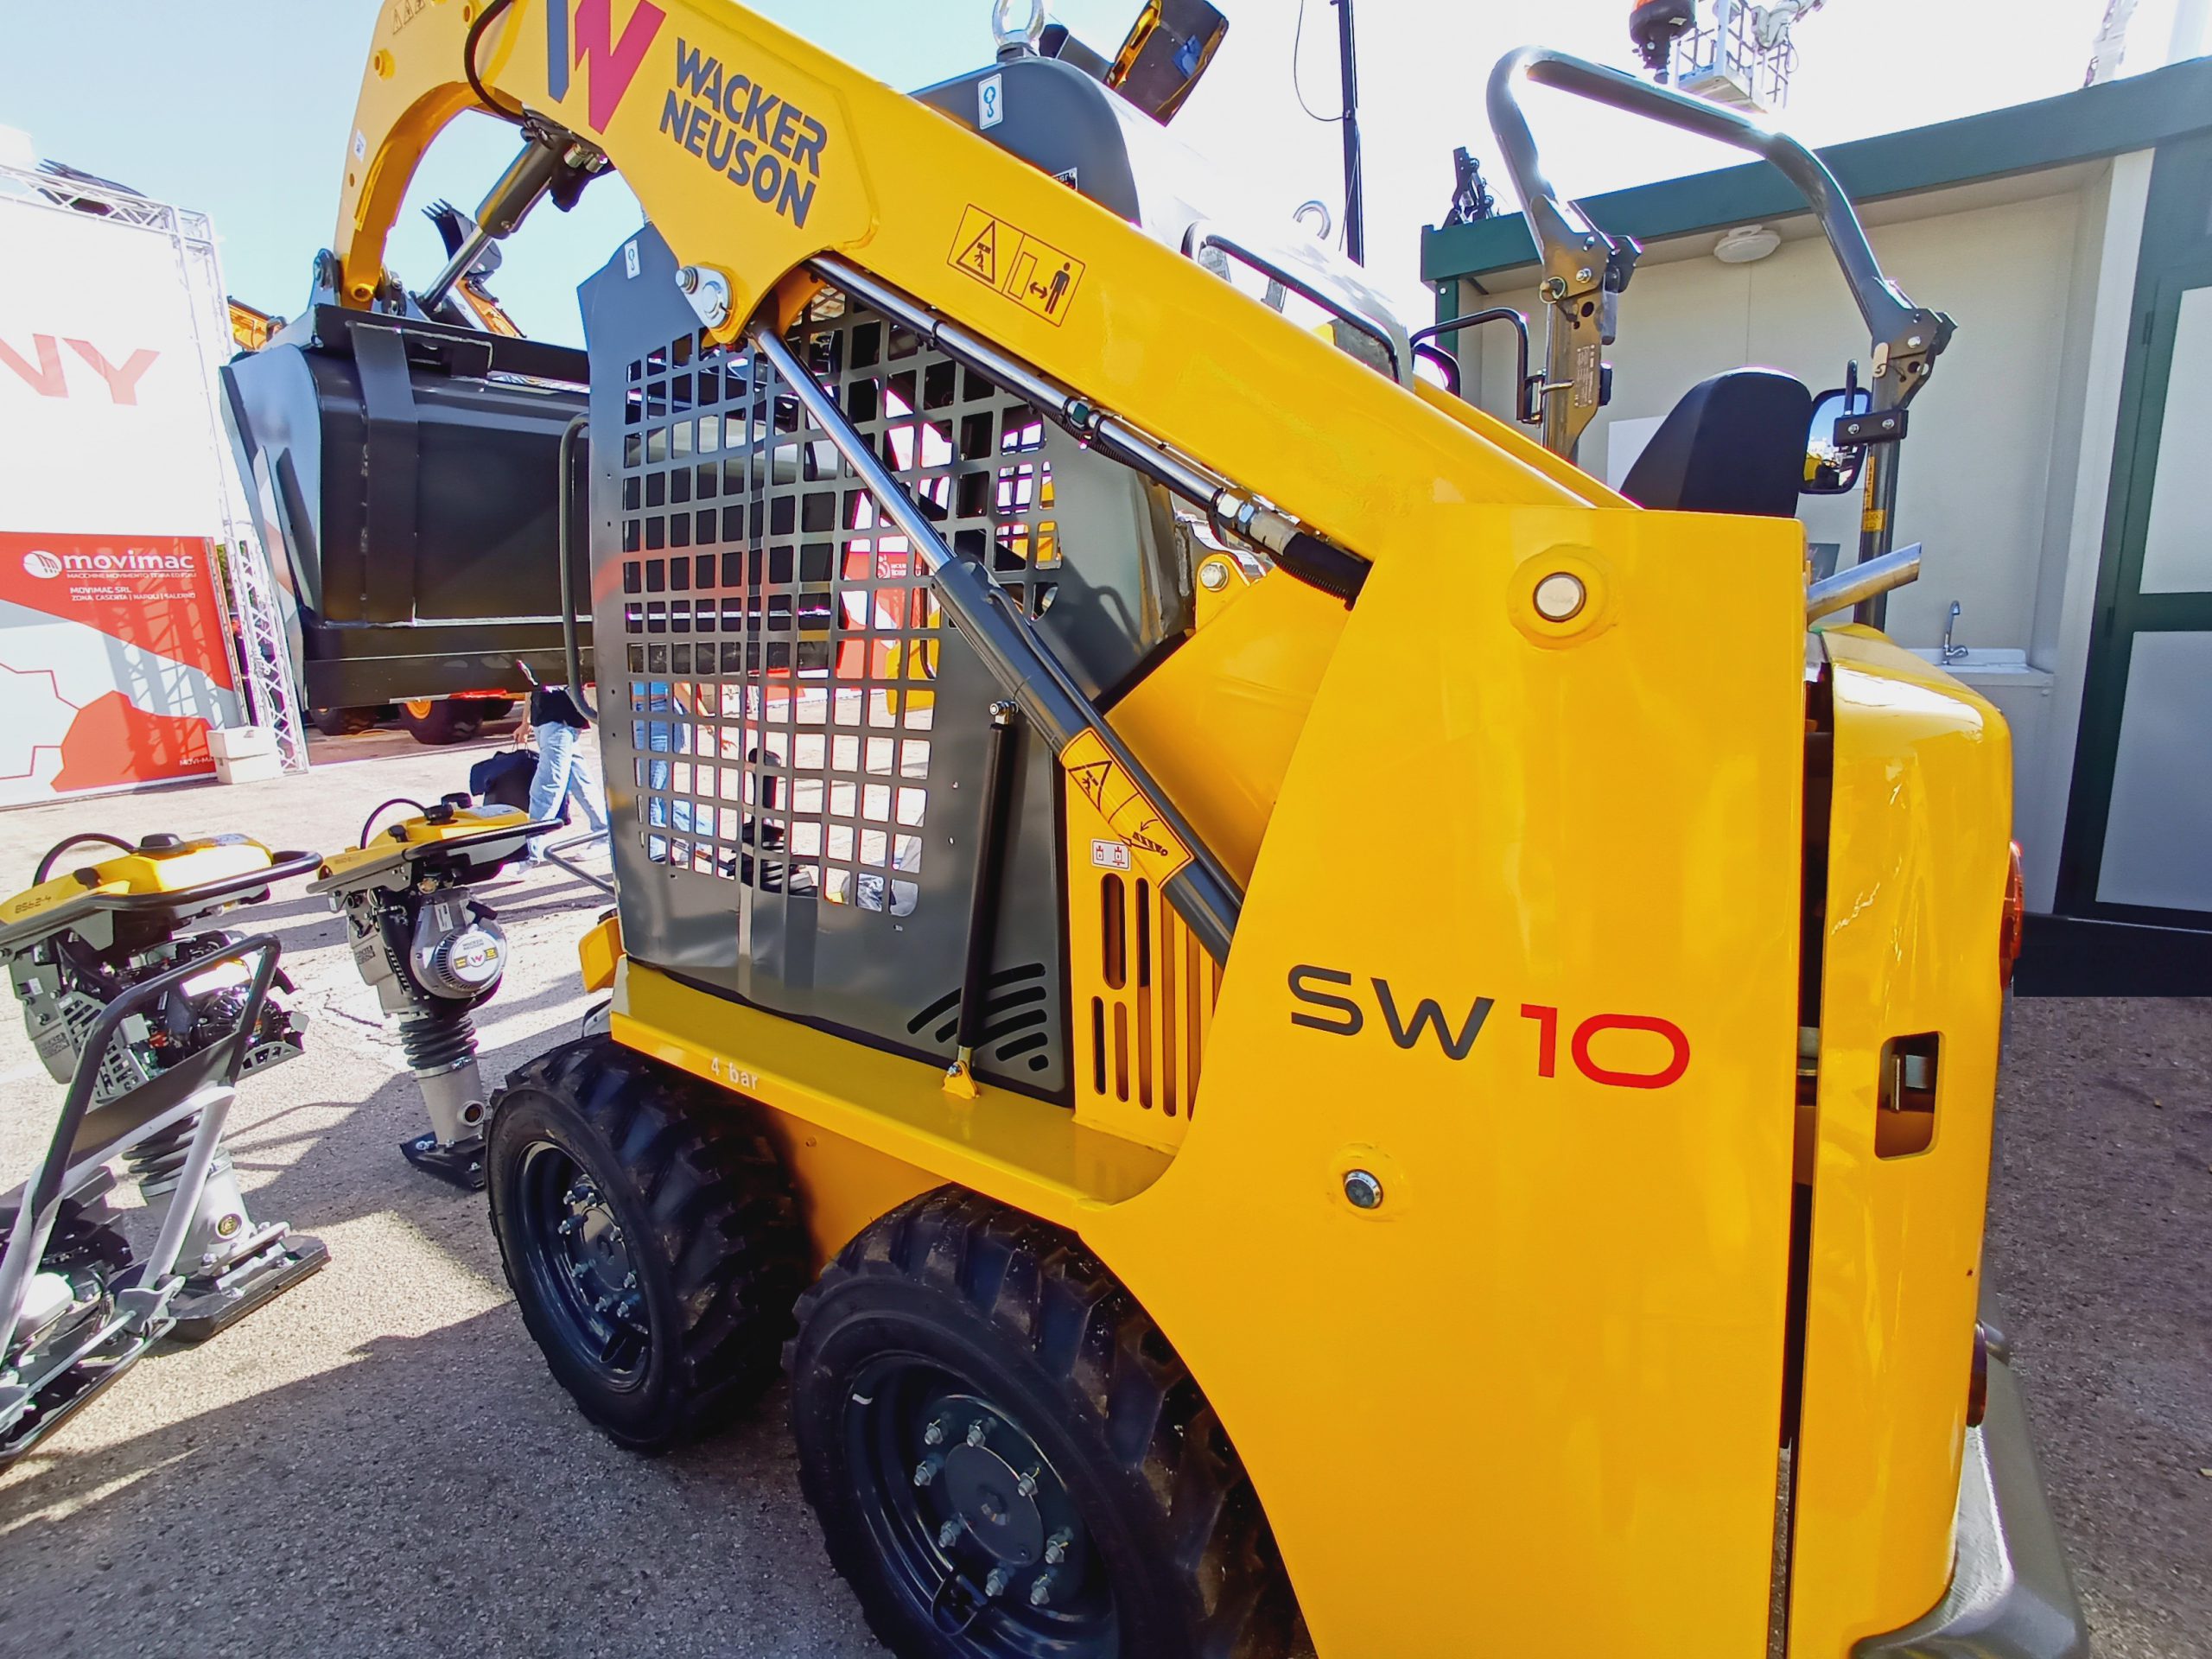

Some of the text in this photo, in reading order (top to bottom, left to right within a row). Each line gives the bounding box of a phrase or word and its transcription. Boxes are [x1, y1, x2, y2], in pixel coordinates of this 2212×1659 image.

[659, 88, 817, 230] NEUSON
[677, 36, 828, 179] WACKER
[62, 550, 194, 570] movimac
[710, 1057, 759, 1090] 4 bar
[1287, 963, 1691, 1090] SW 10
